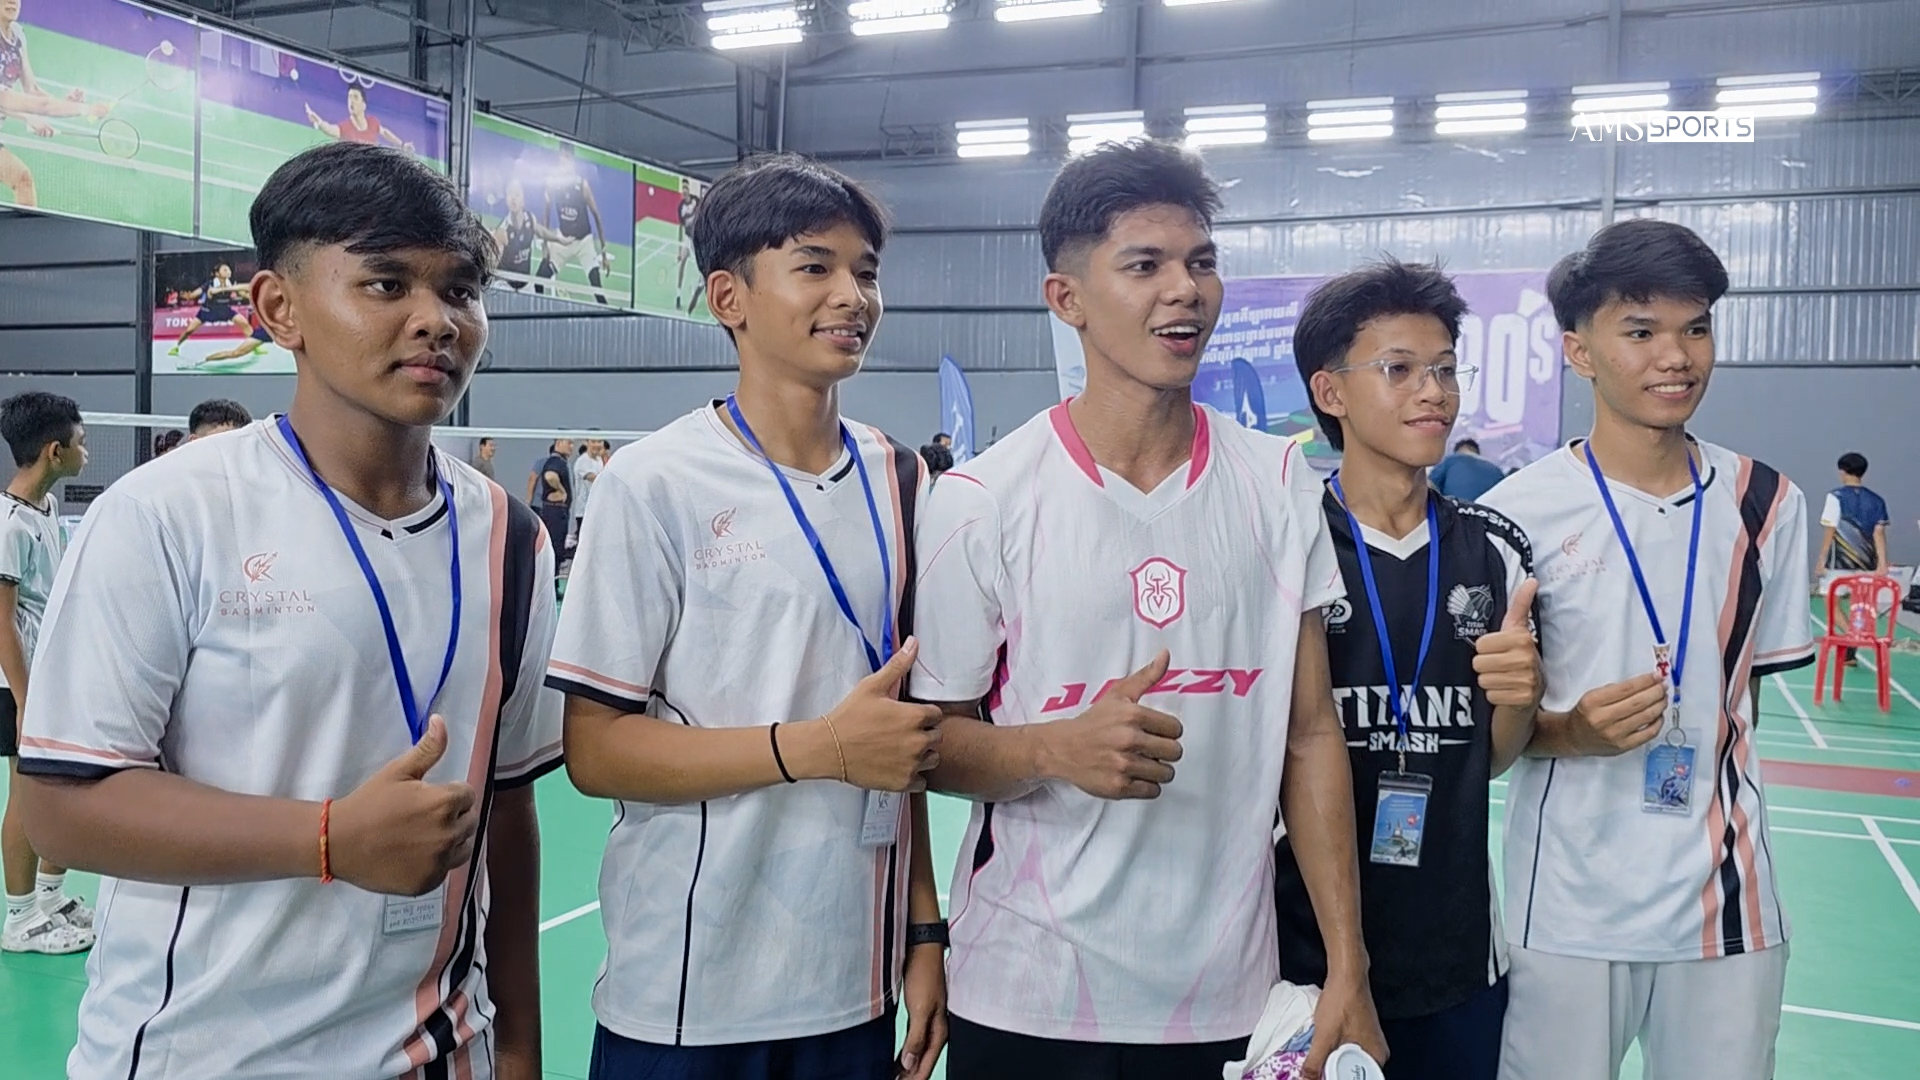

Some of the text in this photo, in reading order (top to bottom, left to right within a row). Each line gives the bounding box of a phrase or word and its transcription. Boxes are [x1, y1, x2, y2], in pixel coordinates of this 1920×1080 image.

[694, 541, 763, 560] CRYSTAL
[696, 553, 766, 570] BADMINTON
[219, 590, 312, 604] CRYSTAL
[220, 605, 315, 616] BADMINTON
[1040, 668, 1264, 713] JZZY
[1369, 731, 1439, 753] SMASH
